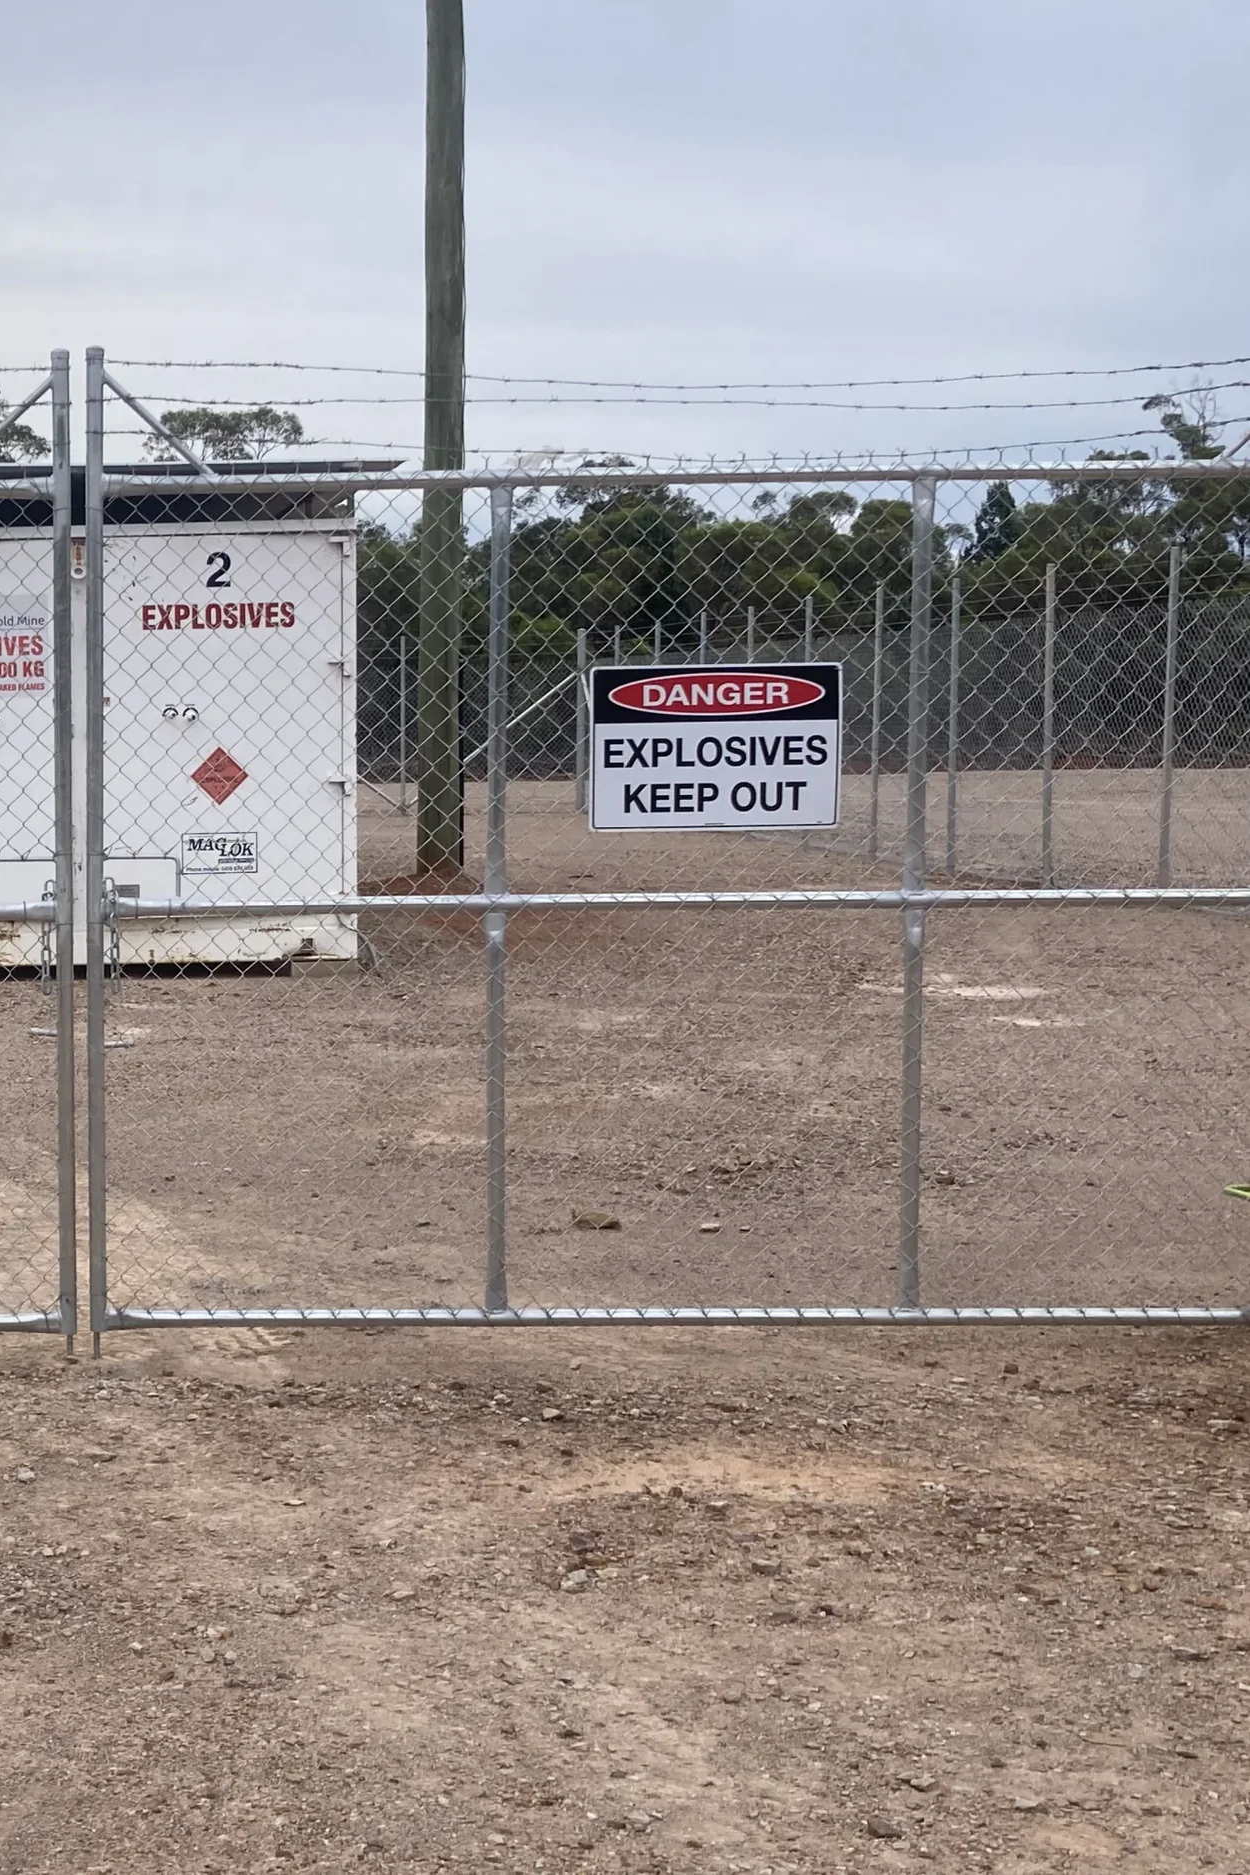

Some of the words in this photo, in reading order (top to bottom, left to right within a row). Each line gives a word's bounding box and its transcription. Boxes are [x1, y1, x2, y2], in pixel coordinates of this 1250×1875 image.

[206, 552, 231, 587] 2
[17, 616, 45, 626] Mine
[142, 602, 295, 630] EXPLOSIVES
[23, 661, 45, 677] KG
[643, 682, 789, 707] DANGER
[604, 735, 828, 768] EXPLOSIVES
[624, 783, 719, 813] KEEP
[731, 781, 807, 812] OUT
